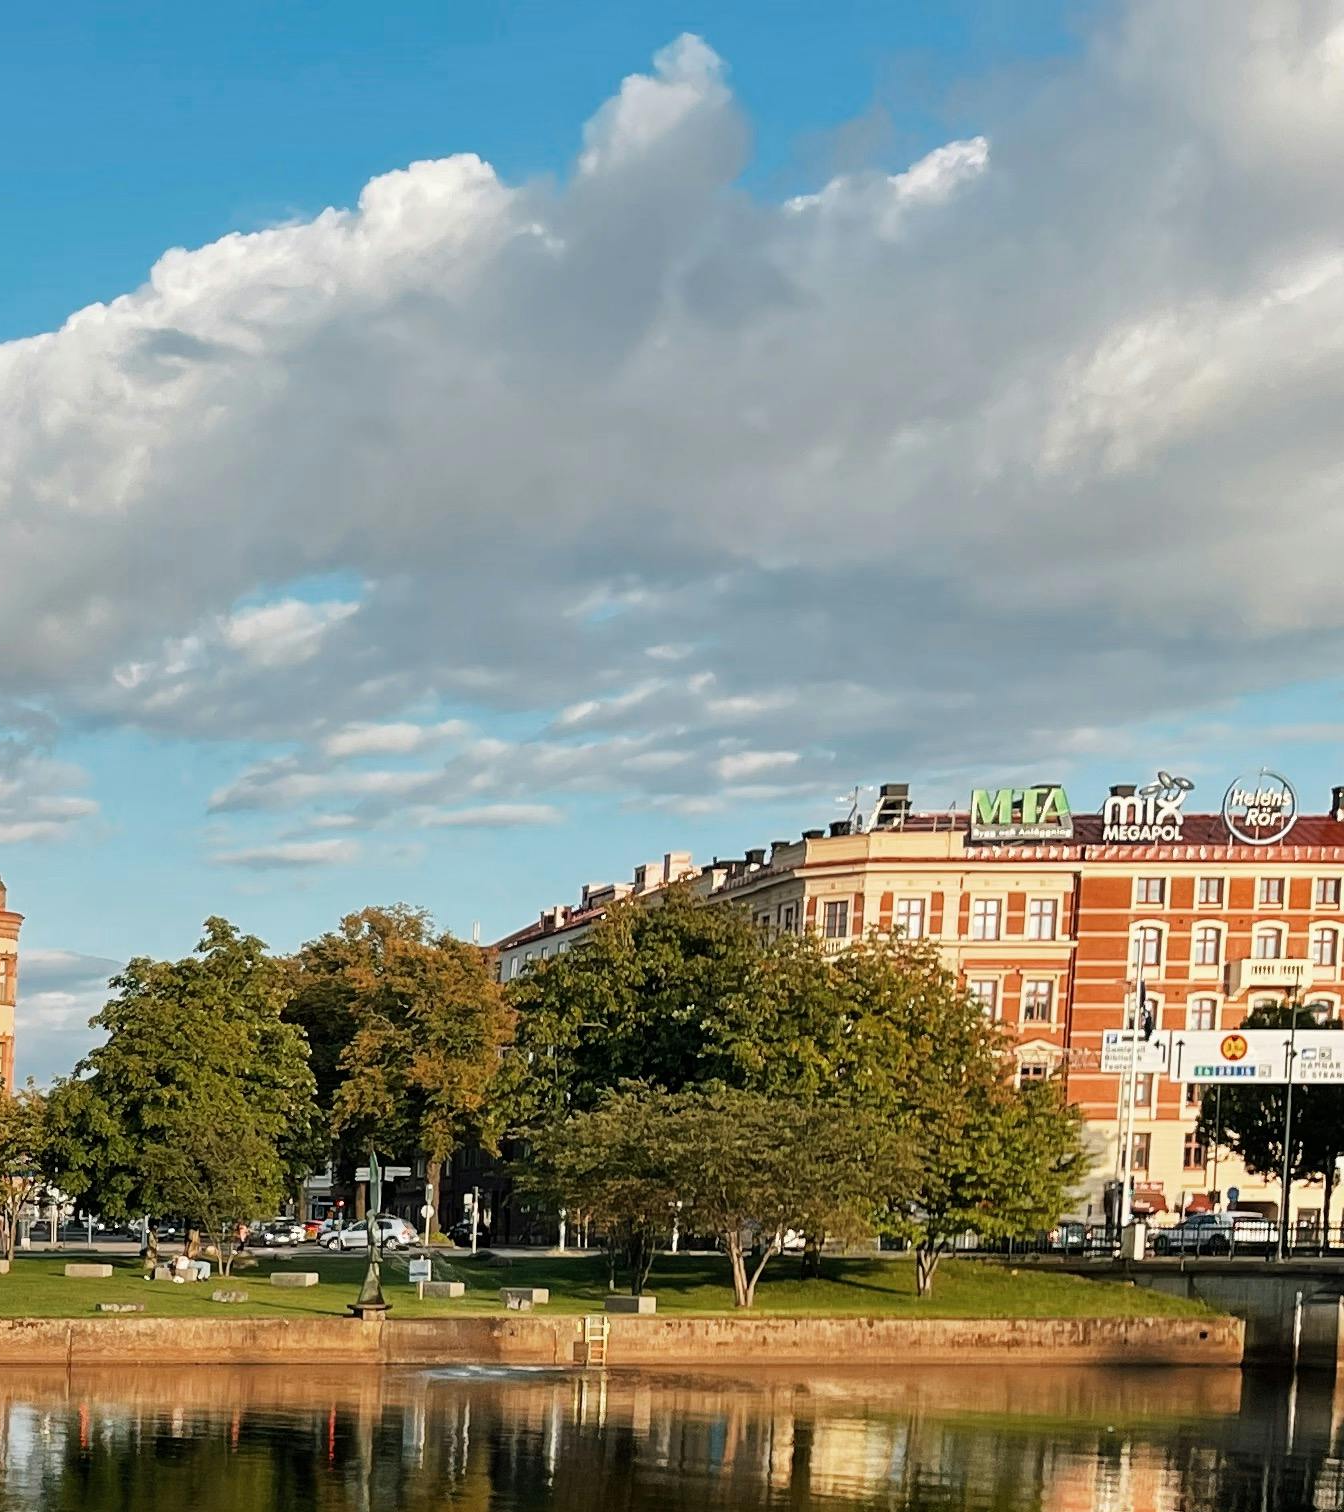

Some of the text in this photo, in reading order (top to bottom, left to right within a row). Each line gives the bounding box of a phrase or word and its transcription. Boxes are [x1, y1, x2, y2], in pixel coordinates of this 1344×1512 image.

[971, 786, 1070, 825] MTA
[1104, 789, 1186, 826] mix
[1245, 806, 1281, 826] Rör
[1103, 825, 1183, 841] MEGAPOL
